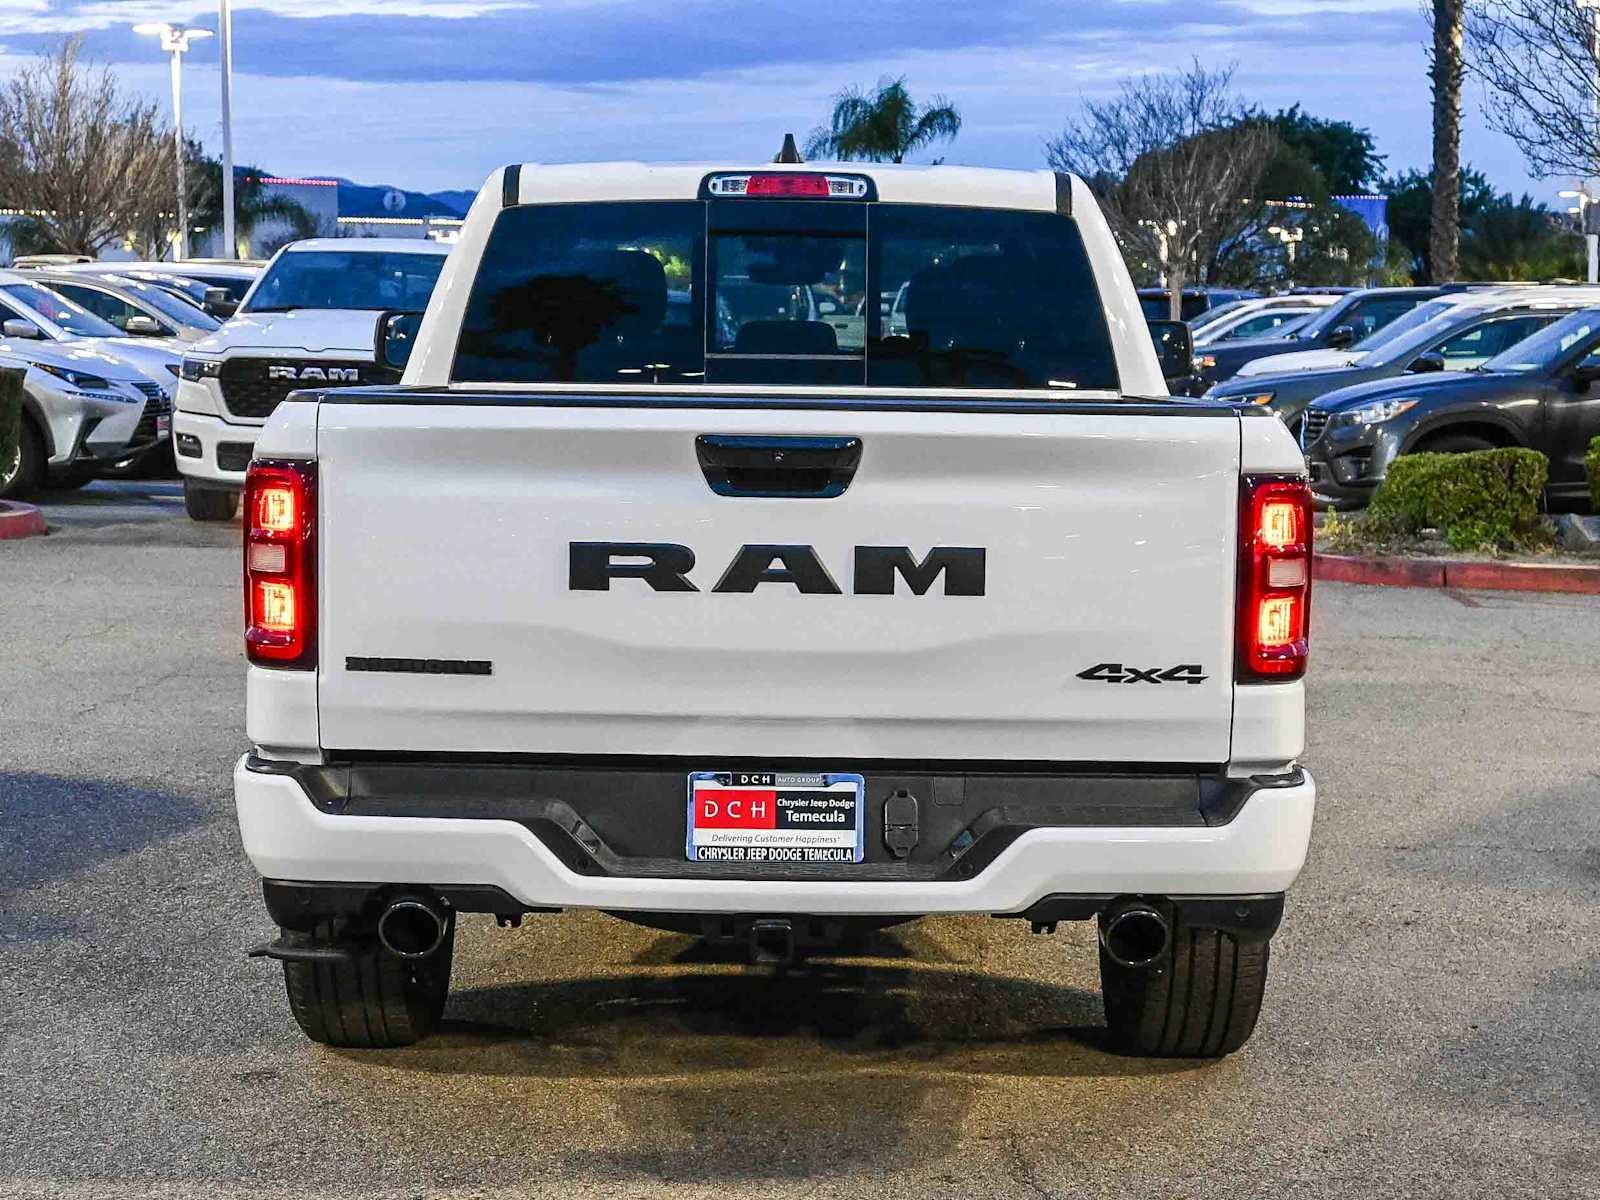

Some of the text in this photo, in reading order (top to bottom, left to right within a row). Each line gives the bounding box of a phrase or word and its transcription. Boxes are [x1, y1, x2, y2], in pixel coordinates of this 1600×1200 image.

[269, 366, 359, 380] RAM
[569, 541, 987, 596] RAM
[1076, 663, 1209, 684] 4x4
[777, 798, 855, 809] Chrysler Jeep Dodge
[786, 810, 846, 823] Temecula
[711, 834, 753, 844] Delivering
[754, 834, 794, 844] Customer
[698, 847, 744, 860] CHRYSLER
[746, 847, 768, 860] JEEP
[769, 848, 801, 861] DODGE
